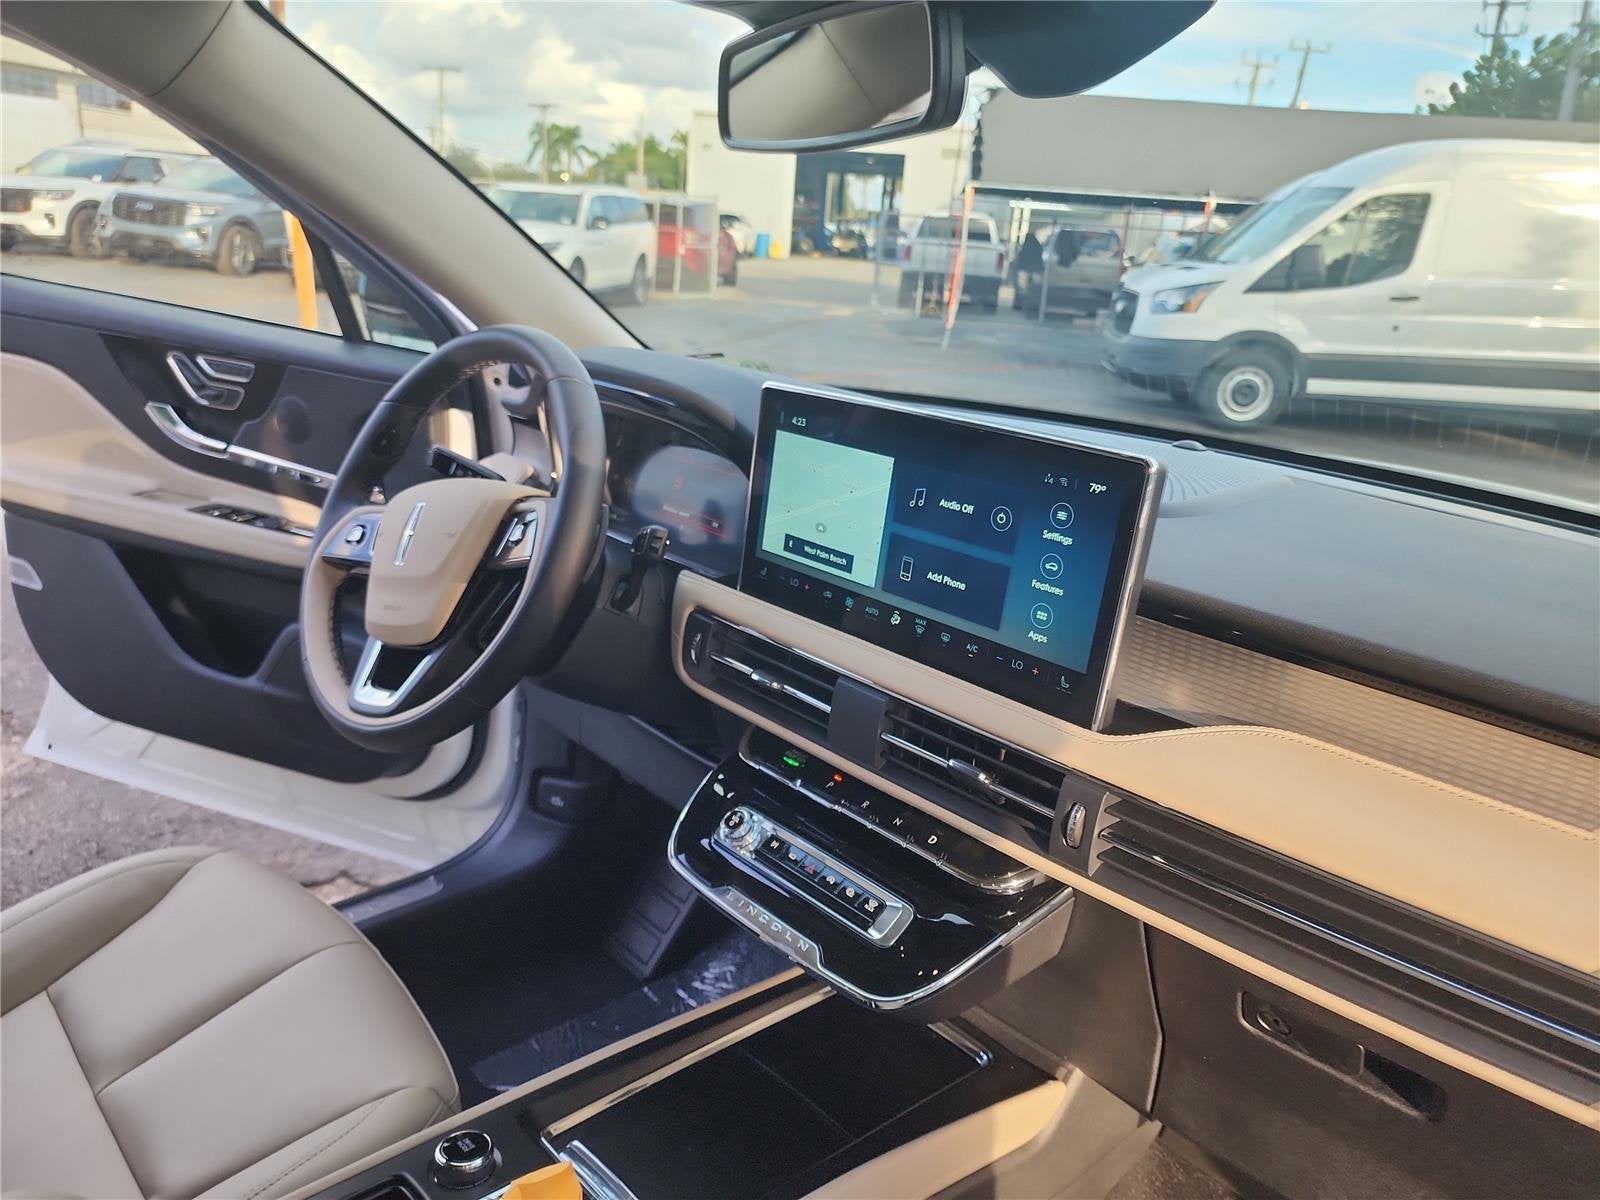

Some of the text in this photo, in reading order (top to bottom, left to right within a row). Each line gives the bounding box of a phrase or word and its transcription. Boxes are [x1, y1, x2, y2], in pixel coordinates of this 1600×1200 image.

[938, 498, 975, 515] Audio Off
[1042, 529, 1074, 546] Settings
[816, 549, 830, 560] Palm
[829, 553, 847, 566] Beach
[926, 571, 966, 591] Add Phone
[1031, 579, 1064, 597] Features
[864, 606, 879, 617] AUTO
[915, 617, 927, 627] MAX
[1027, 630, 1048, 644] Apps
[966, 643, 979, 653] A/C
[1011, 659, 1024, 671] LO
[861, 800, 870, 809] R
[892, 817, 903, 826] N
[927, 835, 938, 845] D
[726, 889, 809, 952] LINCOLN
